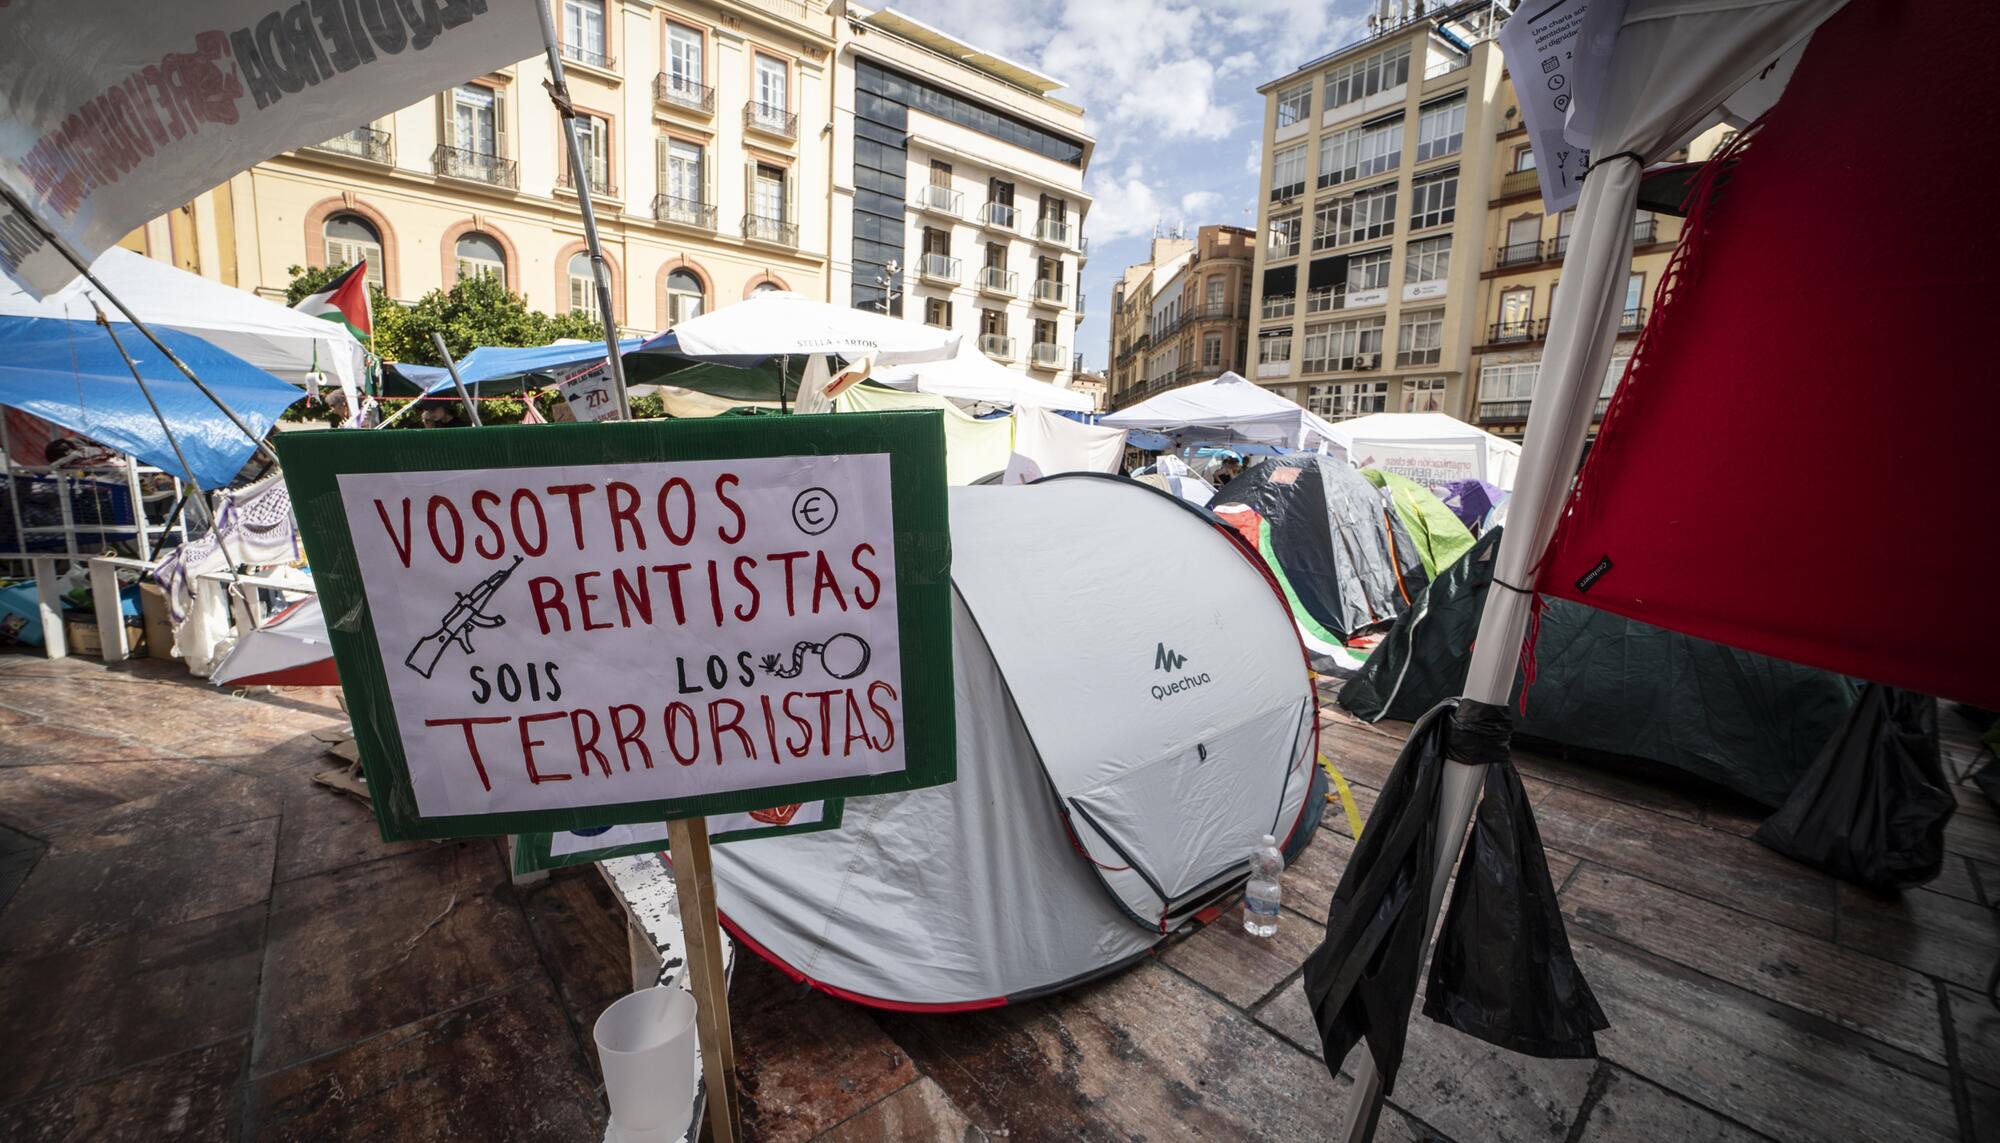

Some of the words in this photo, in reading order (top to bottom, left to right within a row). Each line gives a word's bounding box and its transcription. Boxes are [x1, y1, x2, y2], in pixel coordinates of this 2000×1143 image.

[1532, 26, 1548, 36] Una
[1549, 14, 1573, 28] charla
[1535, 23, 1571, 45] identidad
[1538, 45, 1548, 53] su
[797, 338, 832, 348] STELLA
[844, 338, 878, 349] ARTOIS
[586, 389, 609, 408] 27J
[374, 472, 747, 568] VOSOTROS
[527, 542, 881, 635] RENTISTAS
[469, 661, 563, 704] SOIS
[677, 650, 756, 693] LOS
[1151, 672, 1211, 701] Quechua
[424, 680, 898, 792] TERRORISTAS
